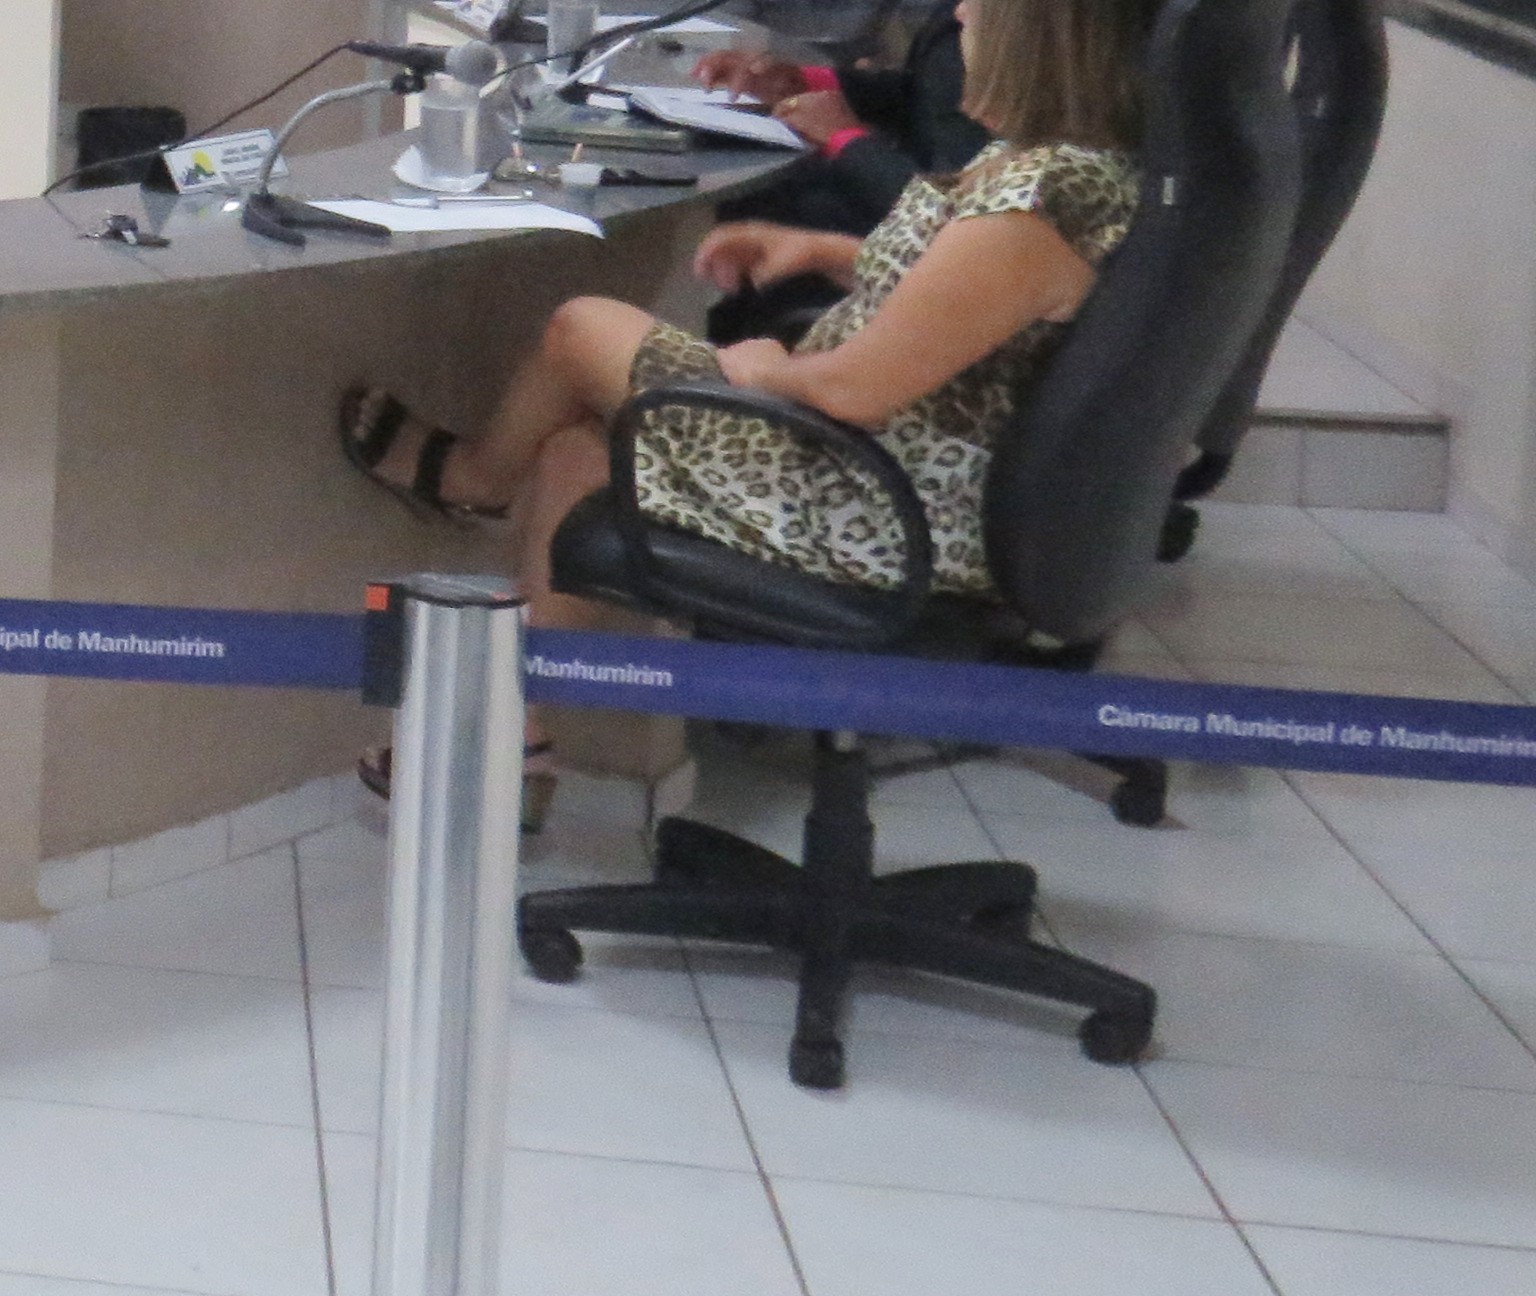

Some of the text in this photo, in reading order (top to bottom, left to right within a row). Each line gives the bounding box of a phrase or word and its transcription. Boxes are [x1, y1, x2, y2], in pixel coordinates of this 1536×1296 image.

[45, 629, 72, 650] de
[78, 631, 225, 658] Manhumirim
[1206, 712, 1335, 743] Municipal
[1341, 724, 1372, 746] de
